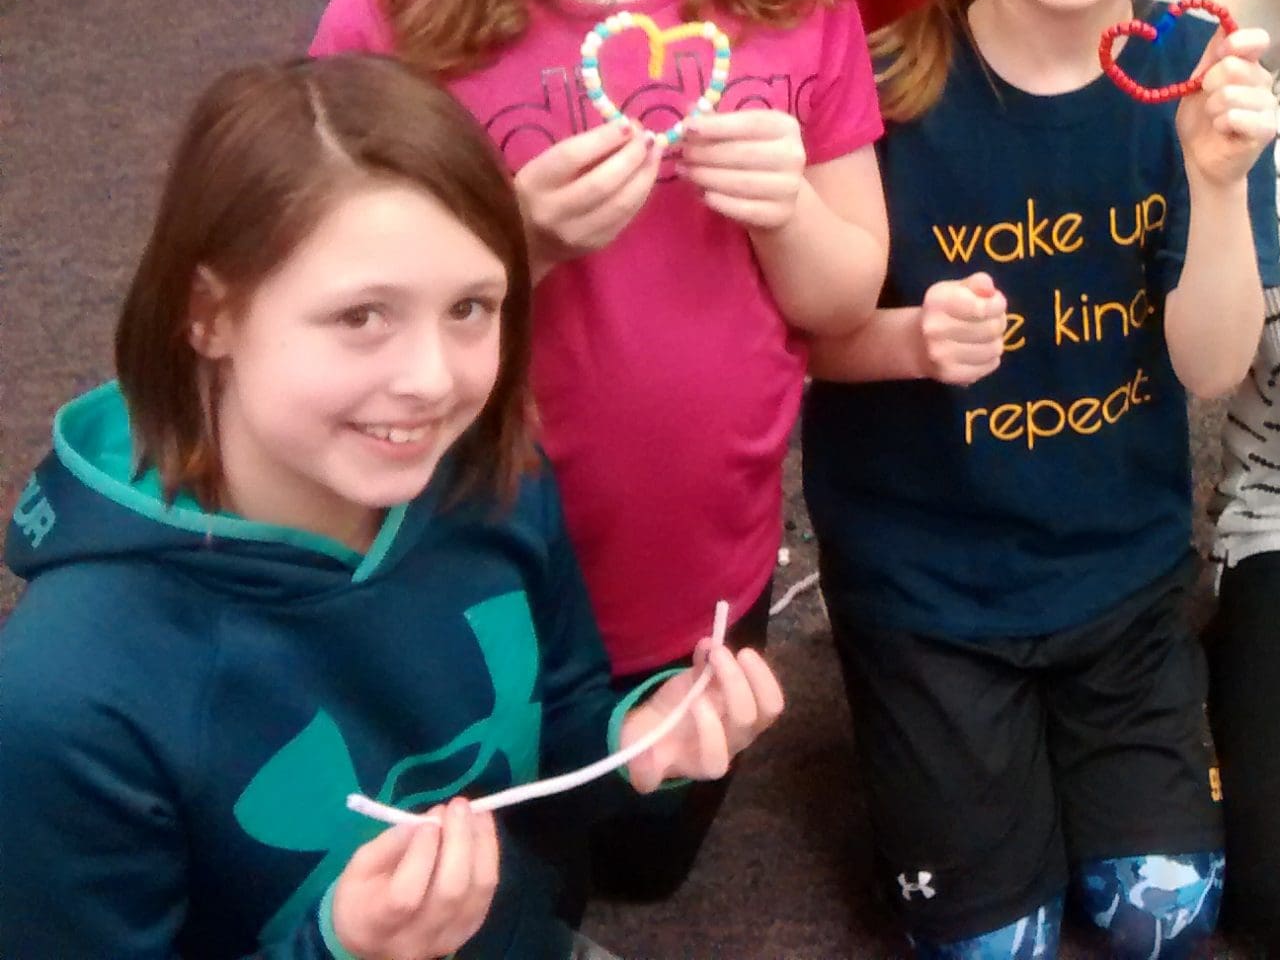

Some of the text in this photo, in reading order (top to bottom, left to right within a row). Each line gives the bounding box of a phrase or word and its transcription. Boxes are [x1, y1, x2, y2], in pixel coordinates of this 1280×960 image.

[931, 197, 1085, 264] wake
[1002, 312, 1026, 352] e
[964, 368, 1152, 451] repeat.
